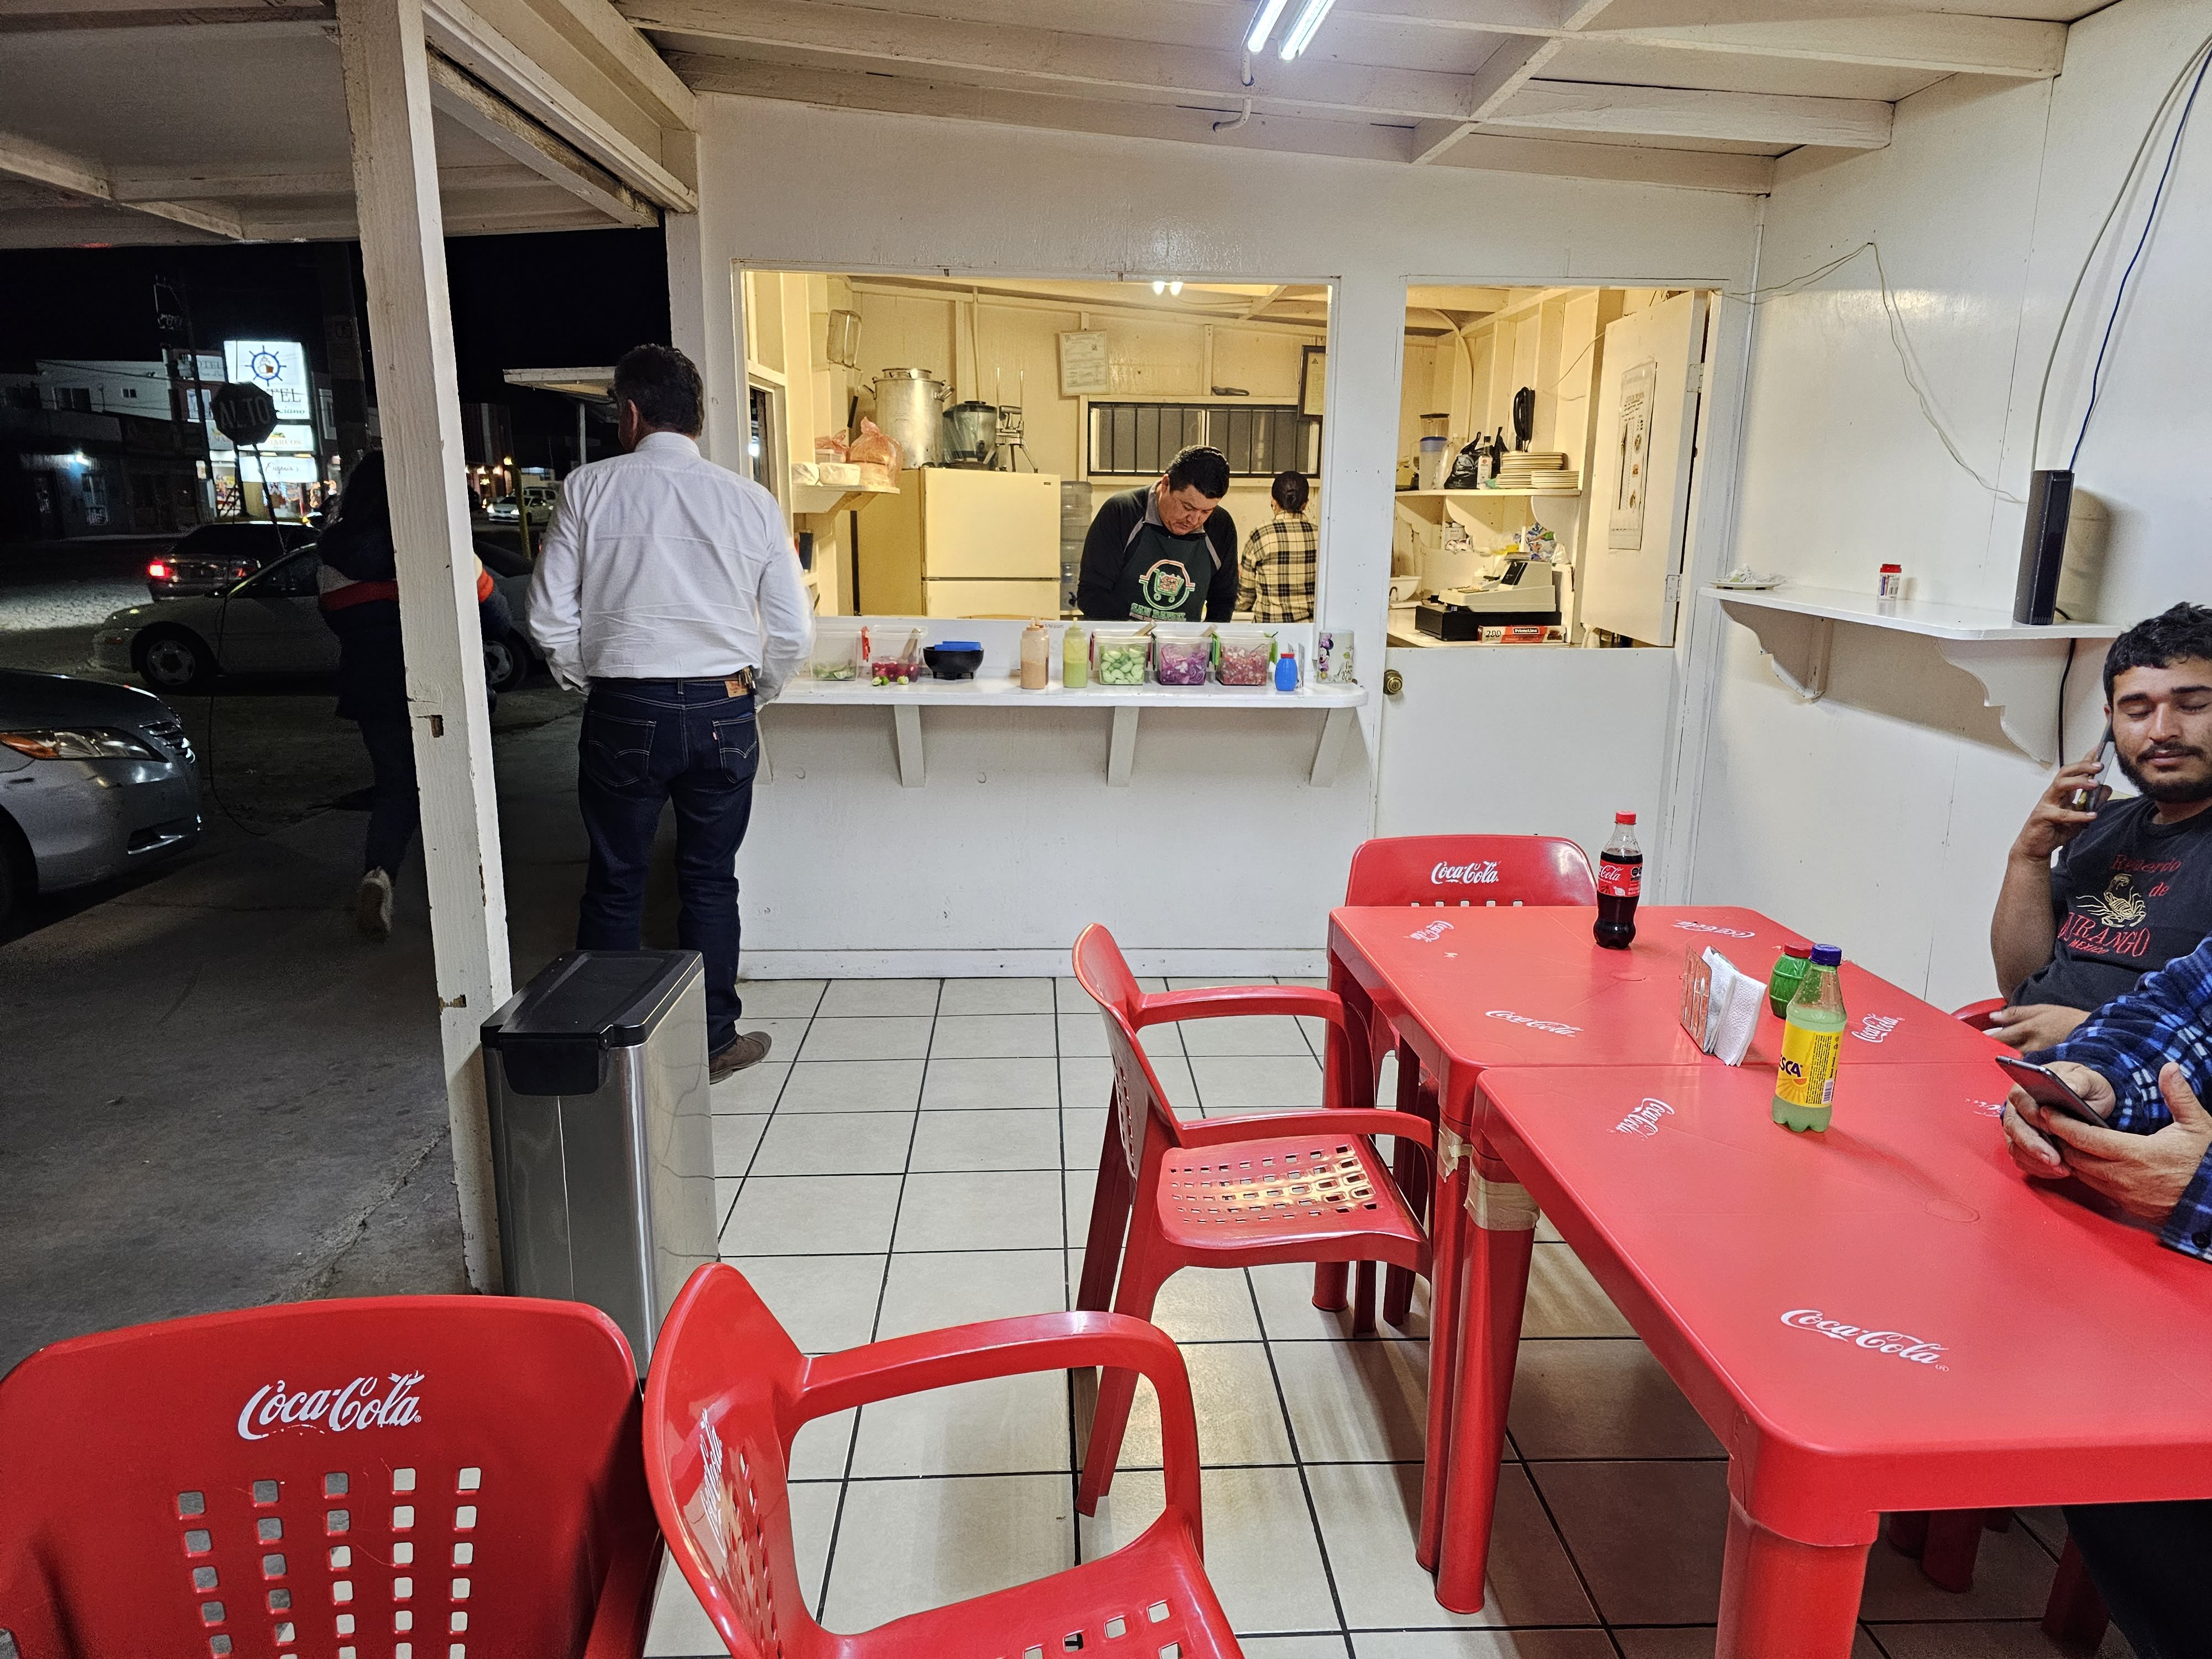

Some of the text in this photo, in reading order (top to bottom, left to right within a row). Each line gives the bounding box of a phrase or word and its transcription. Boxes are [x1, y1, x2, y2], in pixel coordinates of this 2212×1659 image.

[219, 396, 272, 429] ALTO
[1431, 860, 1500, 884] Coca-Cola
[2149, 881, 2169, 897] de
[1485, 1010, 1584, 1036] Coca-Cola
[1851, 1013, 1899, 1043] Coca-Cola
[1615, 1098, 1674, 1140] Coca-Cola
[1780, 1309, 1949, 1366] Coca-Cola
[238, 1370, 424, 1440] Coca-Cola
